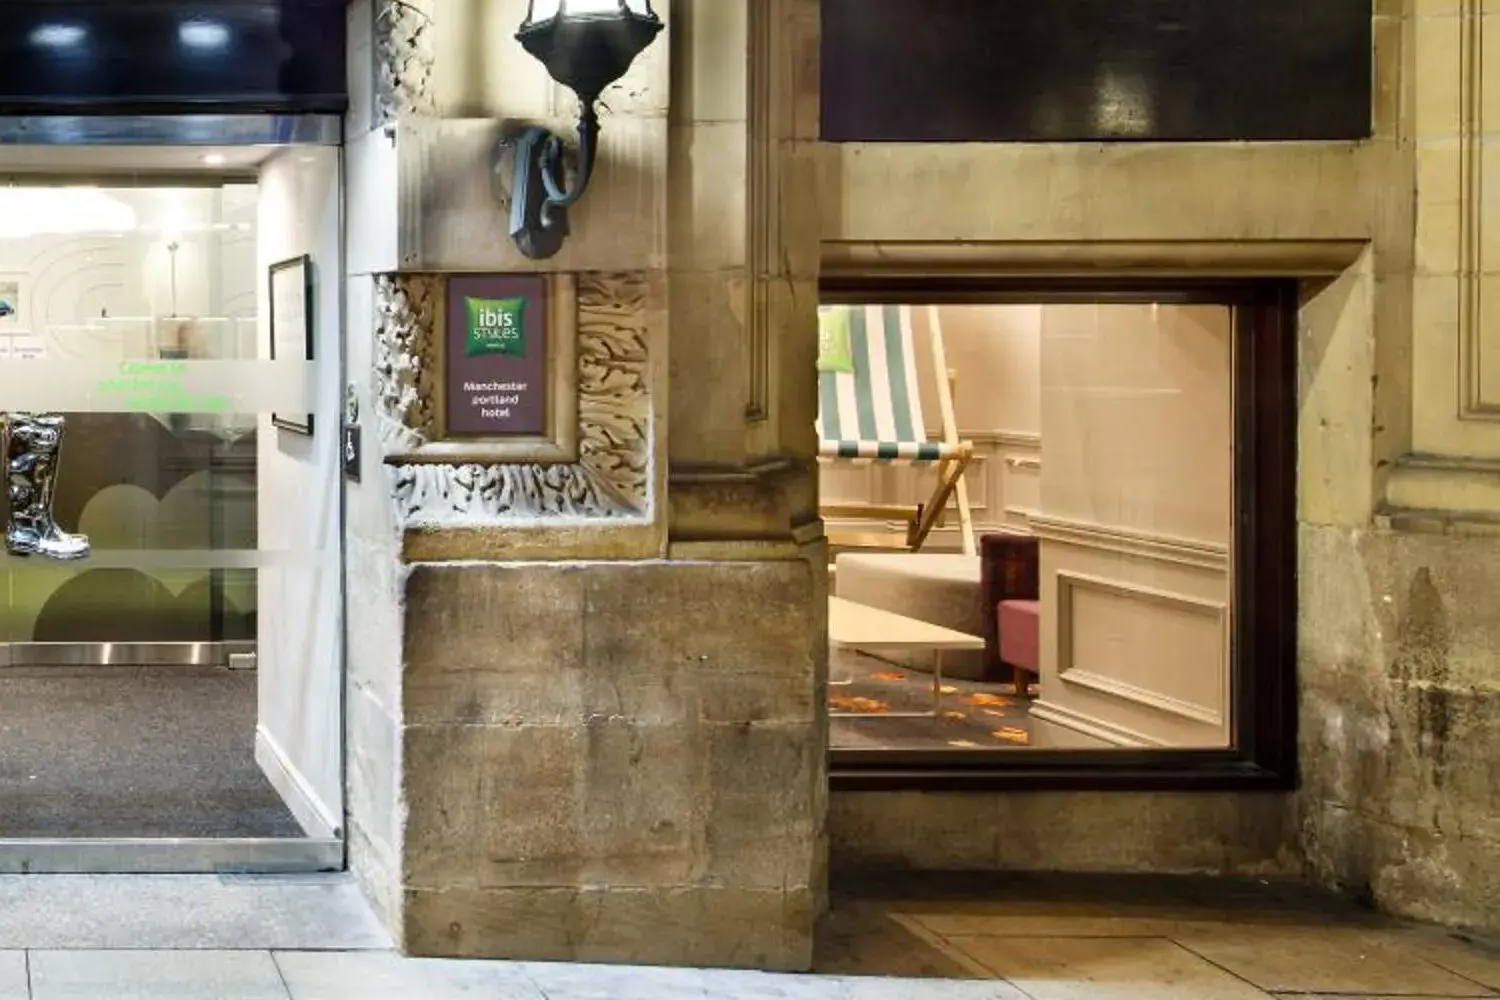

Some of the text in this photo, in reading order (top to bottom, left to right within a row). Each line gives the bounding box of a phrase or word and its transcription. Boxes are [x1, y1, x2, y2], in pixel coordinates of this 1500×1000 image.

[479, 308, 513, 327] ibis
[464, 381, 527, 392] Manchester
[472, 394, 519, 405] portland
[481, 408, 510, 418] hotel
